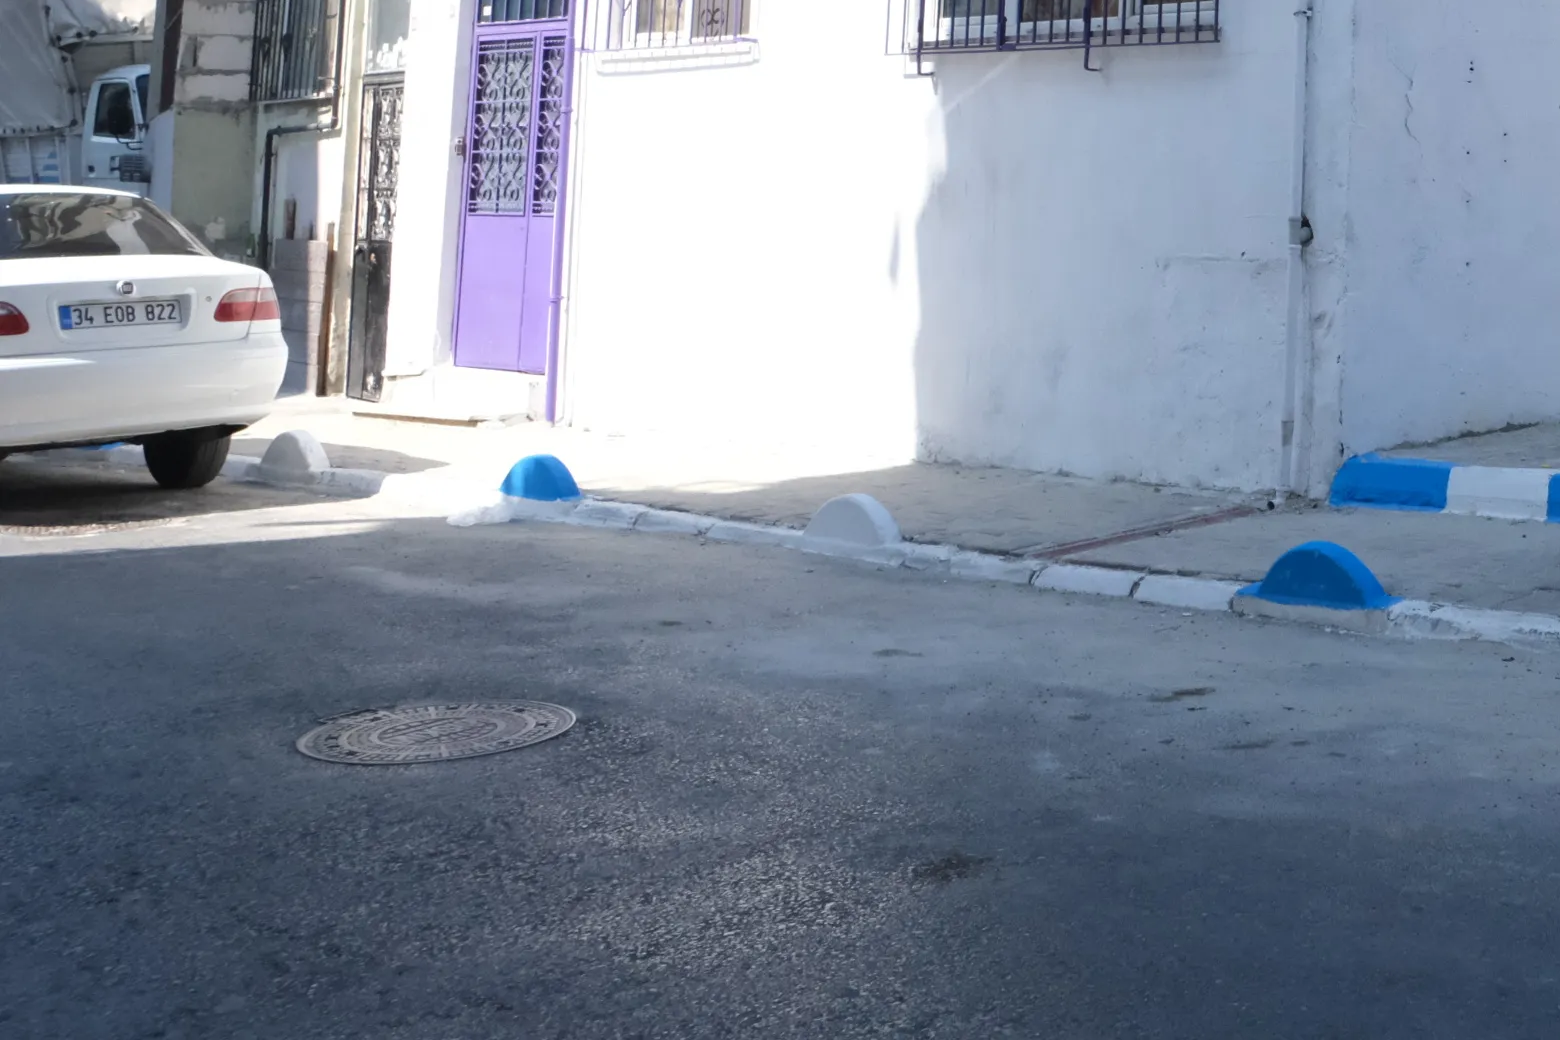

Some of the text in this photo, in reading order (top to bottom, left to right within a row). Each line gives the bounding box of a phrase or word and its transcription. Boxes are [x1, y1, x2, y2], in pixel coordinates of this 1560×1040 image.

[72, 303, 177, 326] 34 EOB 822
